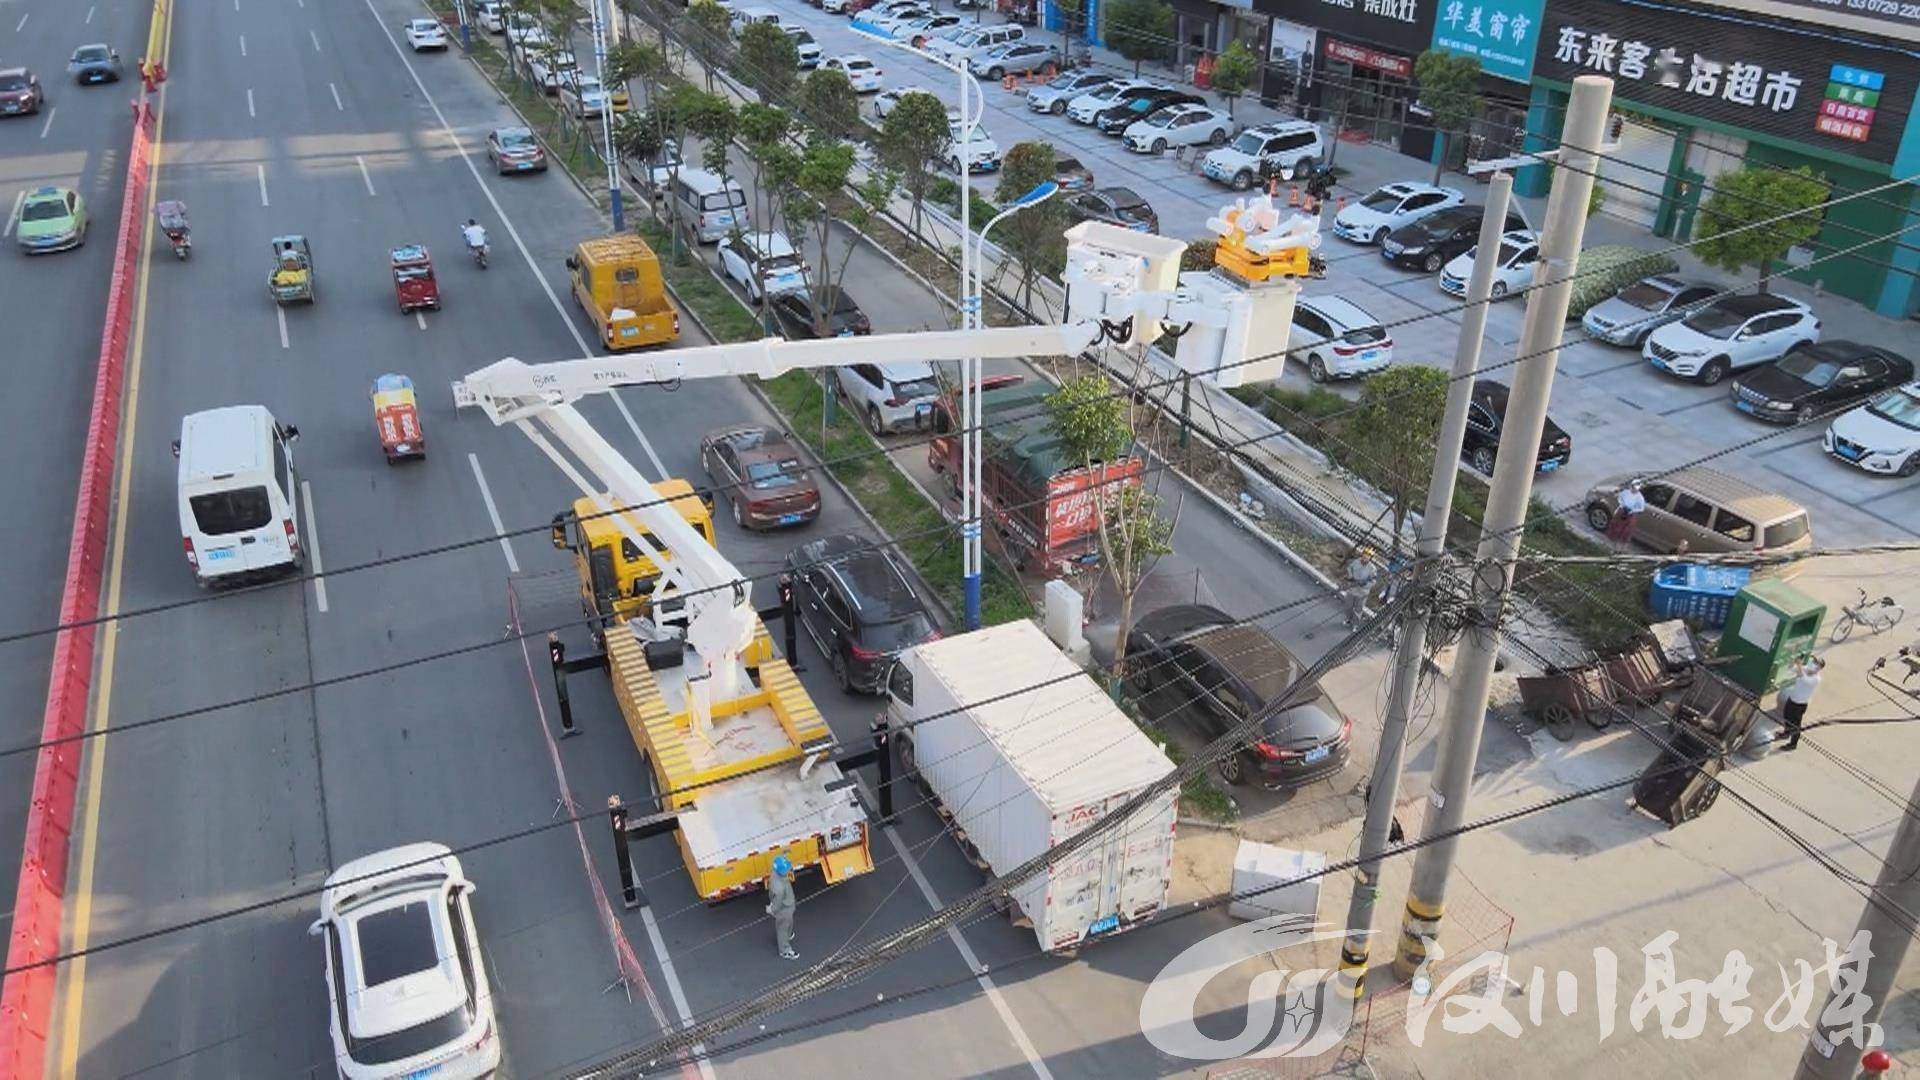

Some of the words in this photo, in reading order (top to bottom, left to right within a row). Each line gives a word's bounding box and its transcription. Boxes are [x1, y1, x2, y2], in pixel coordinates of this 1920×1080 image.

[1443, 1, 1532, 48] 华美窗帘
[1064, 806, 1100, 824] JAC
